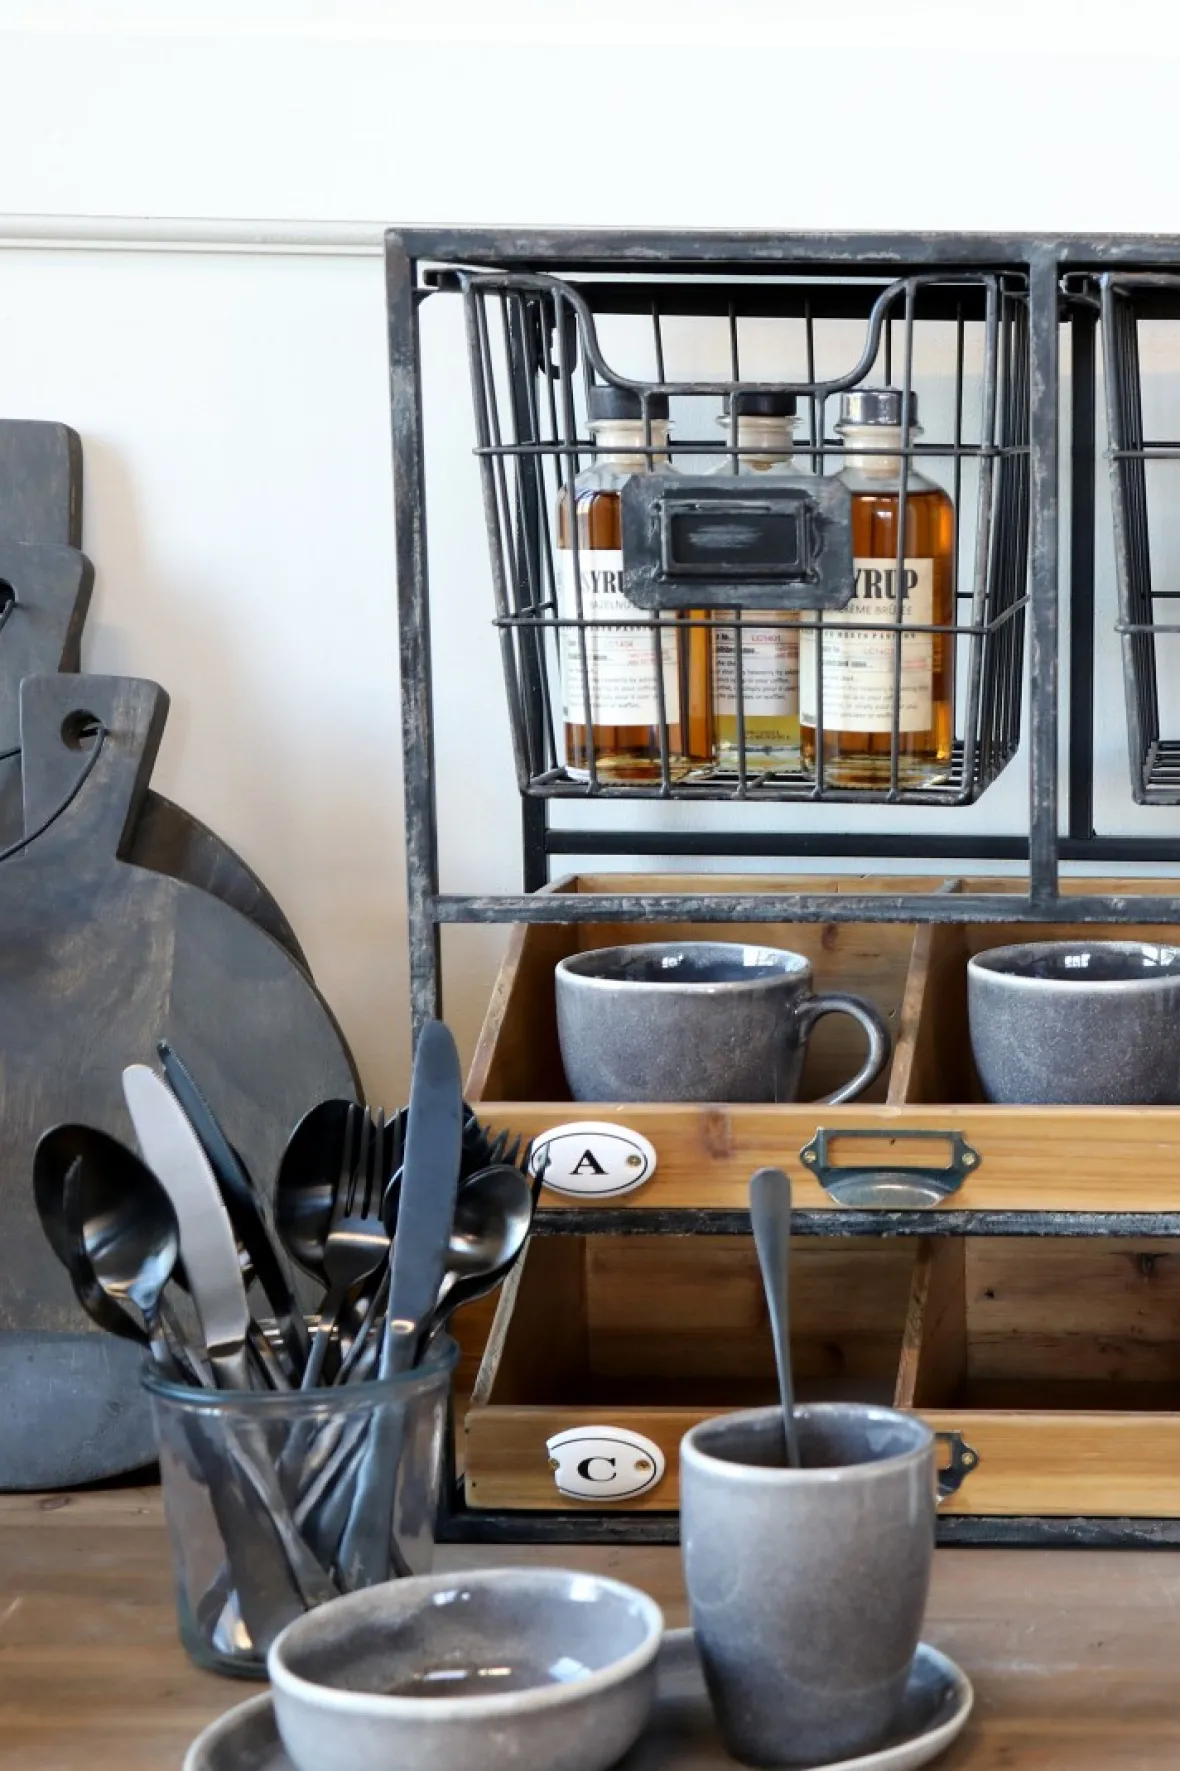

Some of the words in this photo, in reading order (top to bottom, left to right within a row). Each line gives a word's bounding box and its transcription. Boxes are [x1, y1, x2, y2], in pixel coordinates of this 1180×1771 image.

[582, 569, 624, 594] SYRU
[852, 568, 918, 599] YRUP
[568, 1149, 609, 1175] A
[577, 1456, 617, 1482] C
